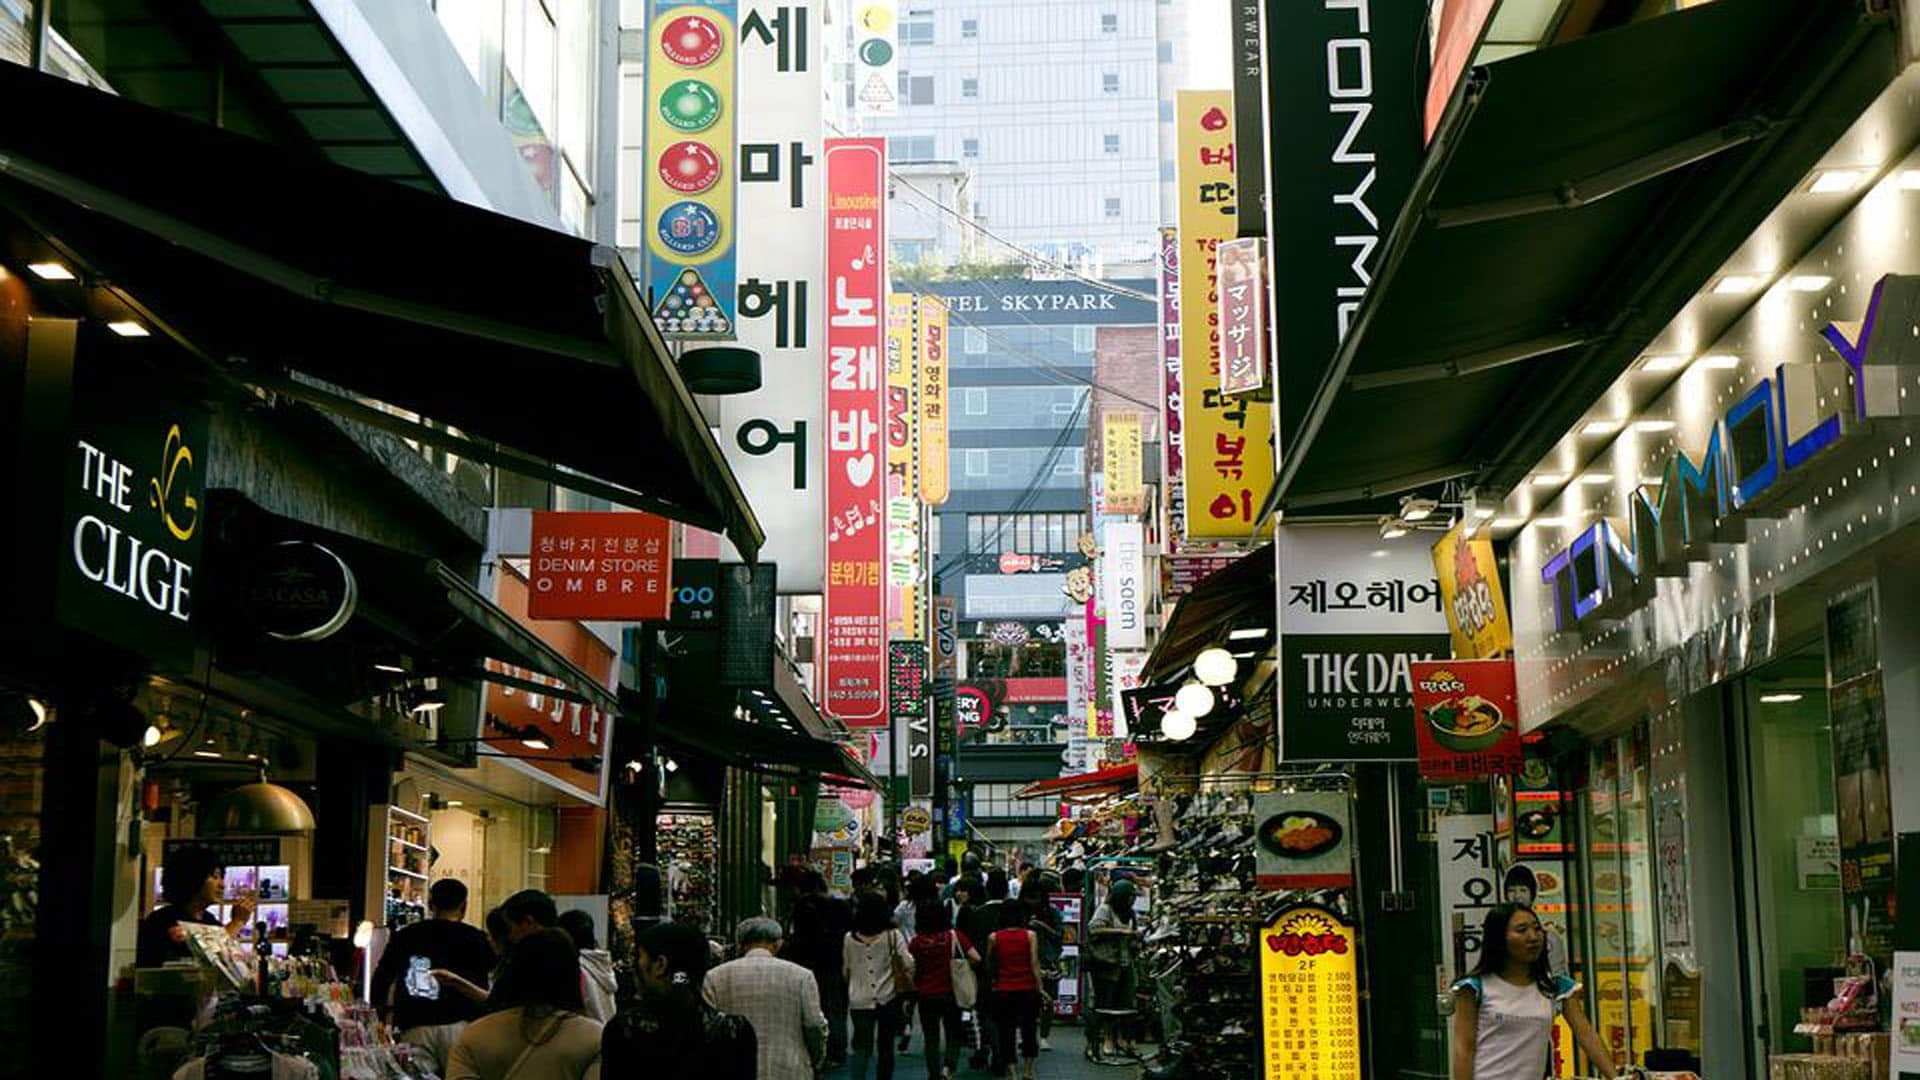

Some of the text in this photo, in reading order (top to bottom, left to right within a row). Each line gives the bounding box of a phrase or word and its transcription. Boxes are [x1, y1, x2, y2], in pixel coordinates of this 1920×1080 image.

[1244, 6, 1259, 77] RWEAR
[737, 7, 813, 490] 세마헤어
[1001, 295, 1117, 311] SKYPARK
[1227, 285, 1250, 378] マッサージ
[888, 386, 909, 448] DVD
[78, 440, 134, 513] THE
[1541, 274, 1892, 630] TONYMOLY
[73, 514, 193, 622] CLIGE
[538, 558, 660, 573] DENIM STORE
[539, 537, 596, 553] 청바지
[536, 577, 657, 594] OMBRE
[1289, 579, 1442, 613] 제오헤어
[1301, 652, 1434, 694] THE DA
[1307, 697, 1415, 709] UNDERWEA
